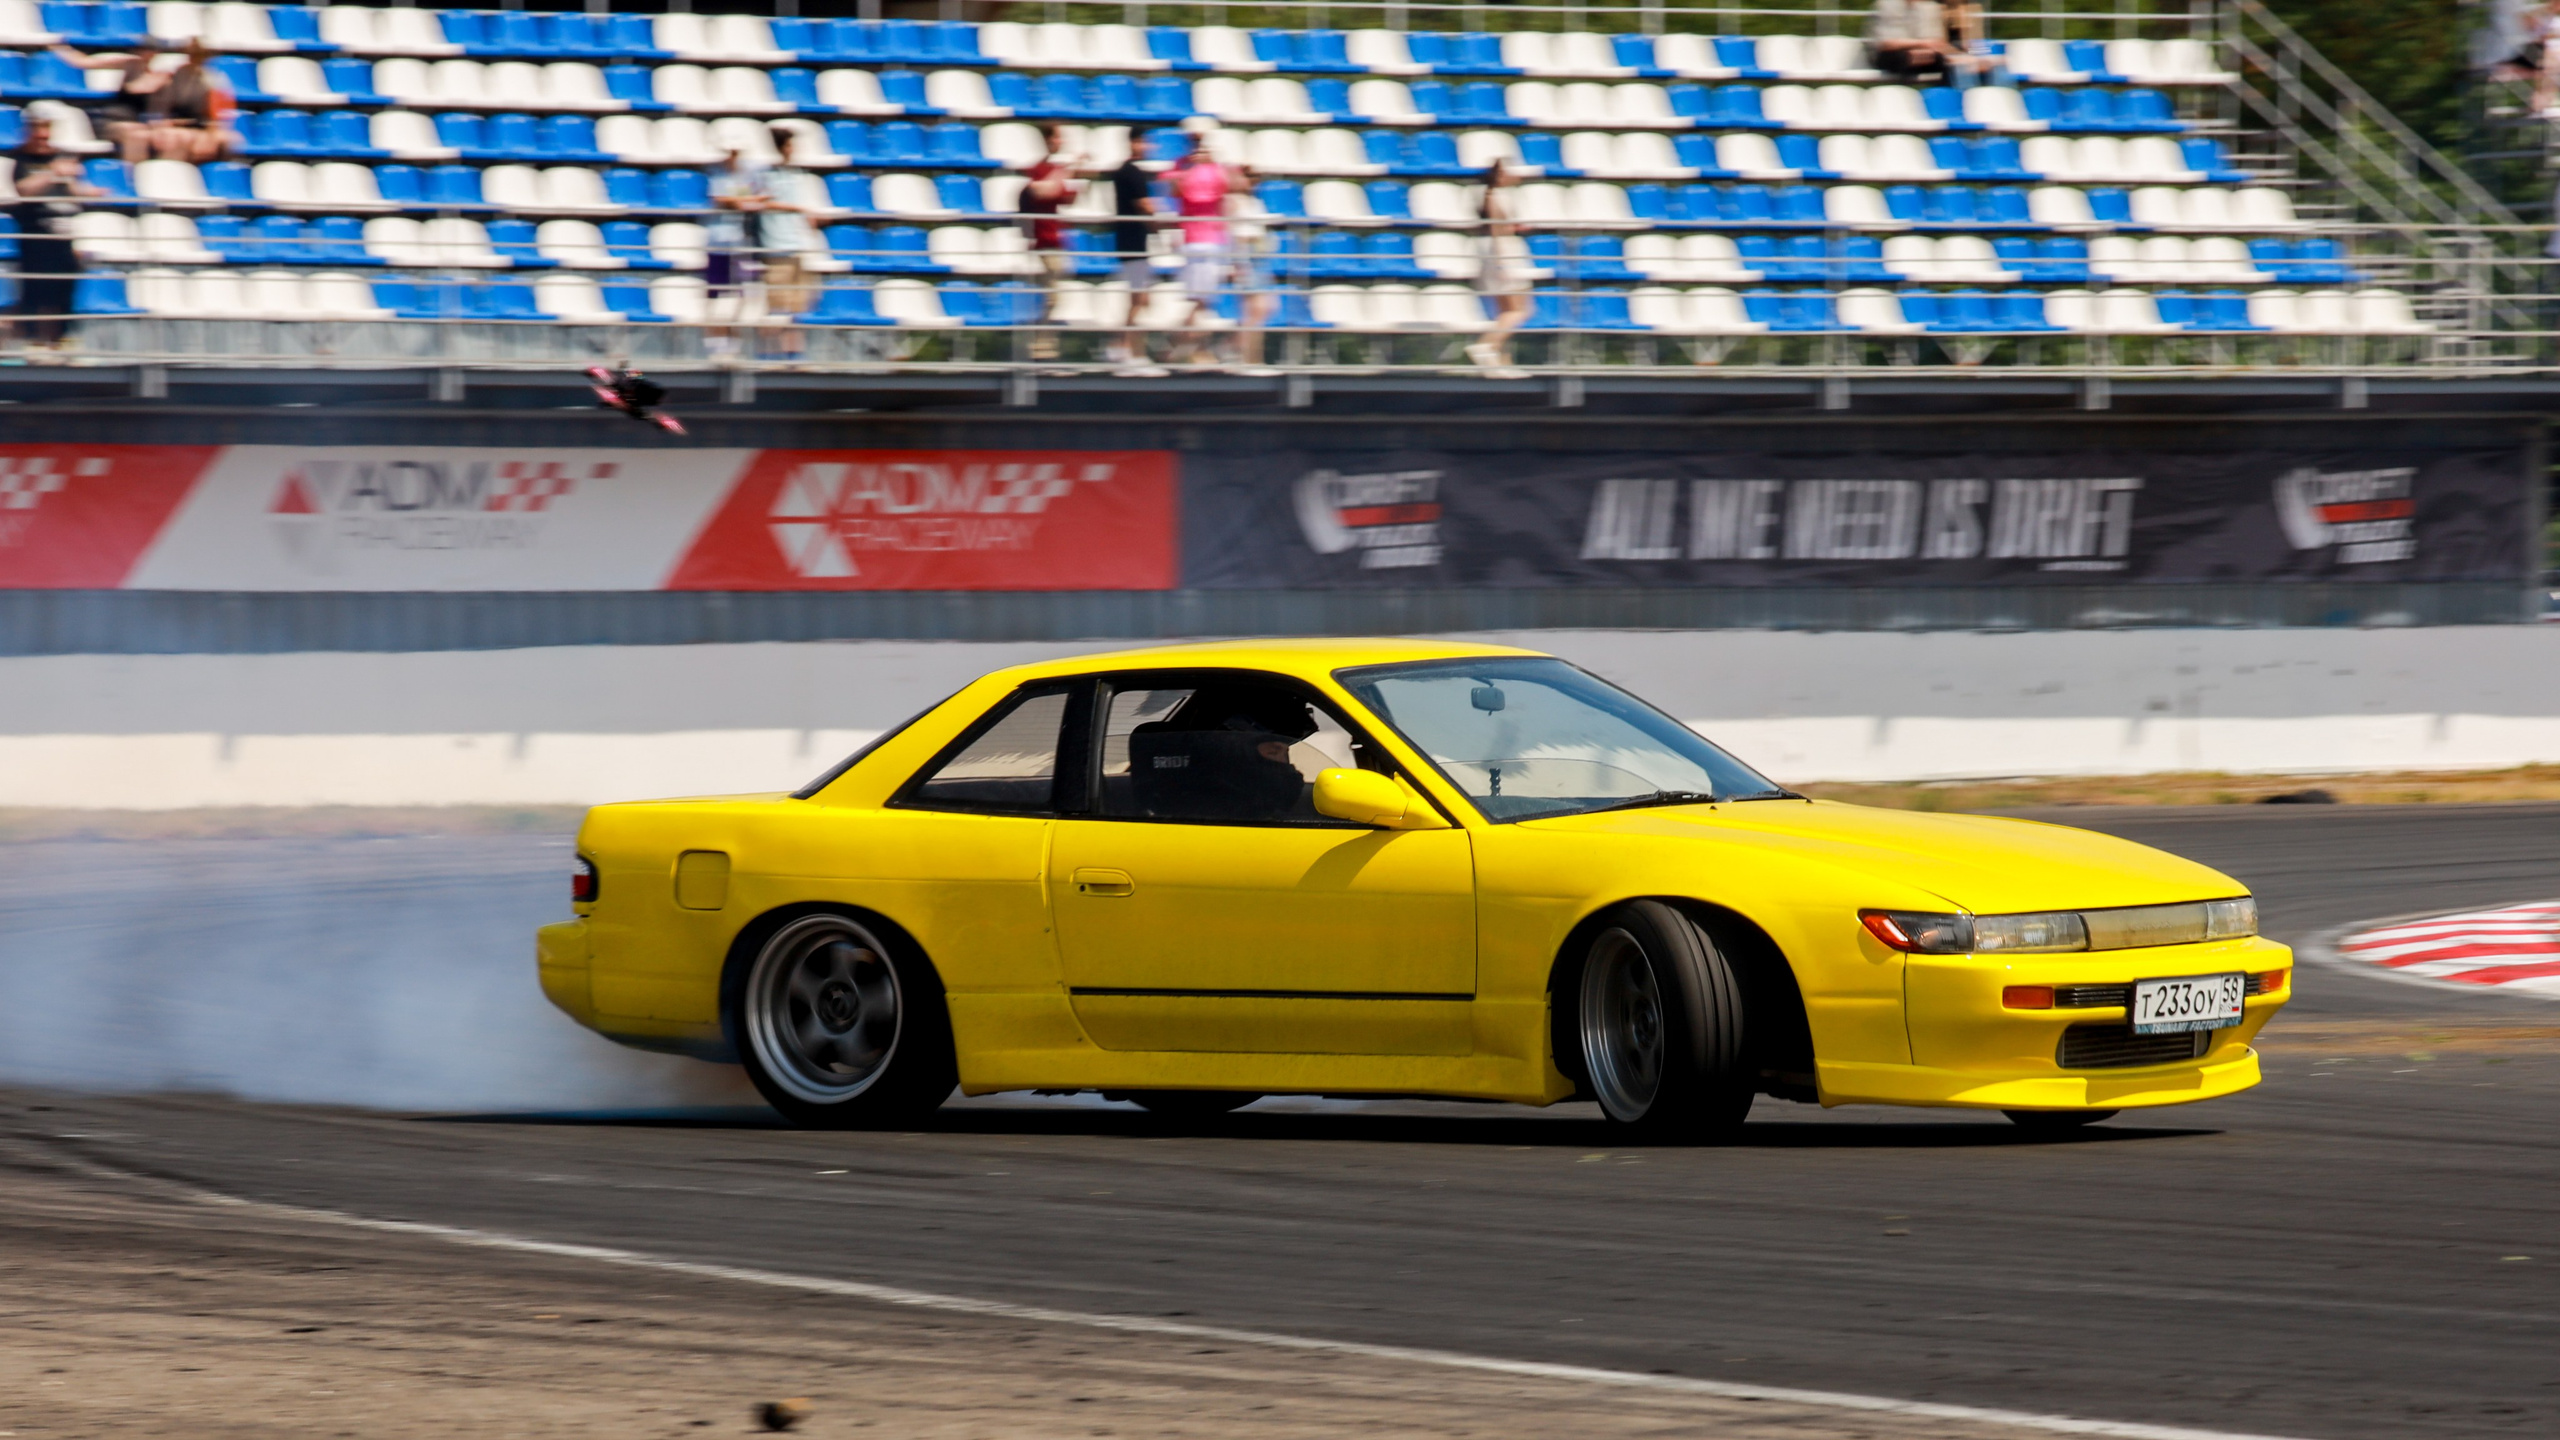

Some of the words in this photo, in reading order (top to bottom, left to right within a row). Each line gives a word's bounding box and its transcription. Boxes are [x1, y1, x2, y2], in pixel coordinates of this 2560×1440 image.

[839, 463, 990, 514] ADM
[839, 518, 1045, 551] RACEWAY
[1579, 479, 1682, 560] ALL
[1689, 479, 1783, 559] WE
[1781, 479, 1922, 560] NEED
[1921, 478, 1988, 560] IS
[1987, 477, 2145, 559] DRIFT
[2222, 977, 2239, 1003] 58
[2189, 1018, 2224, 1031] FACTORY
